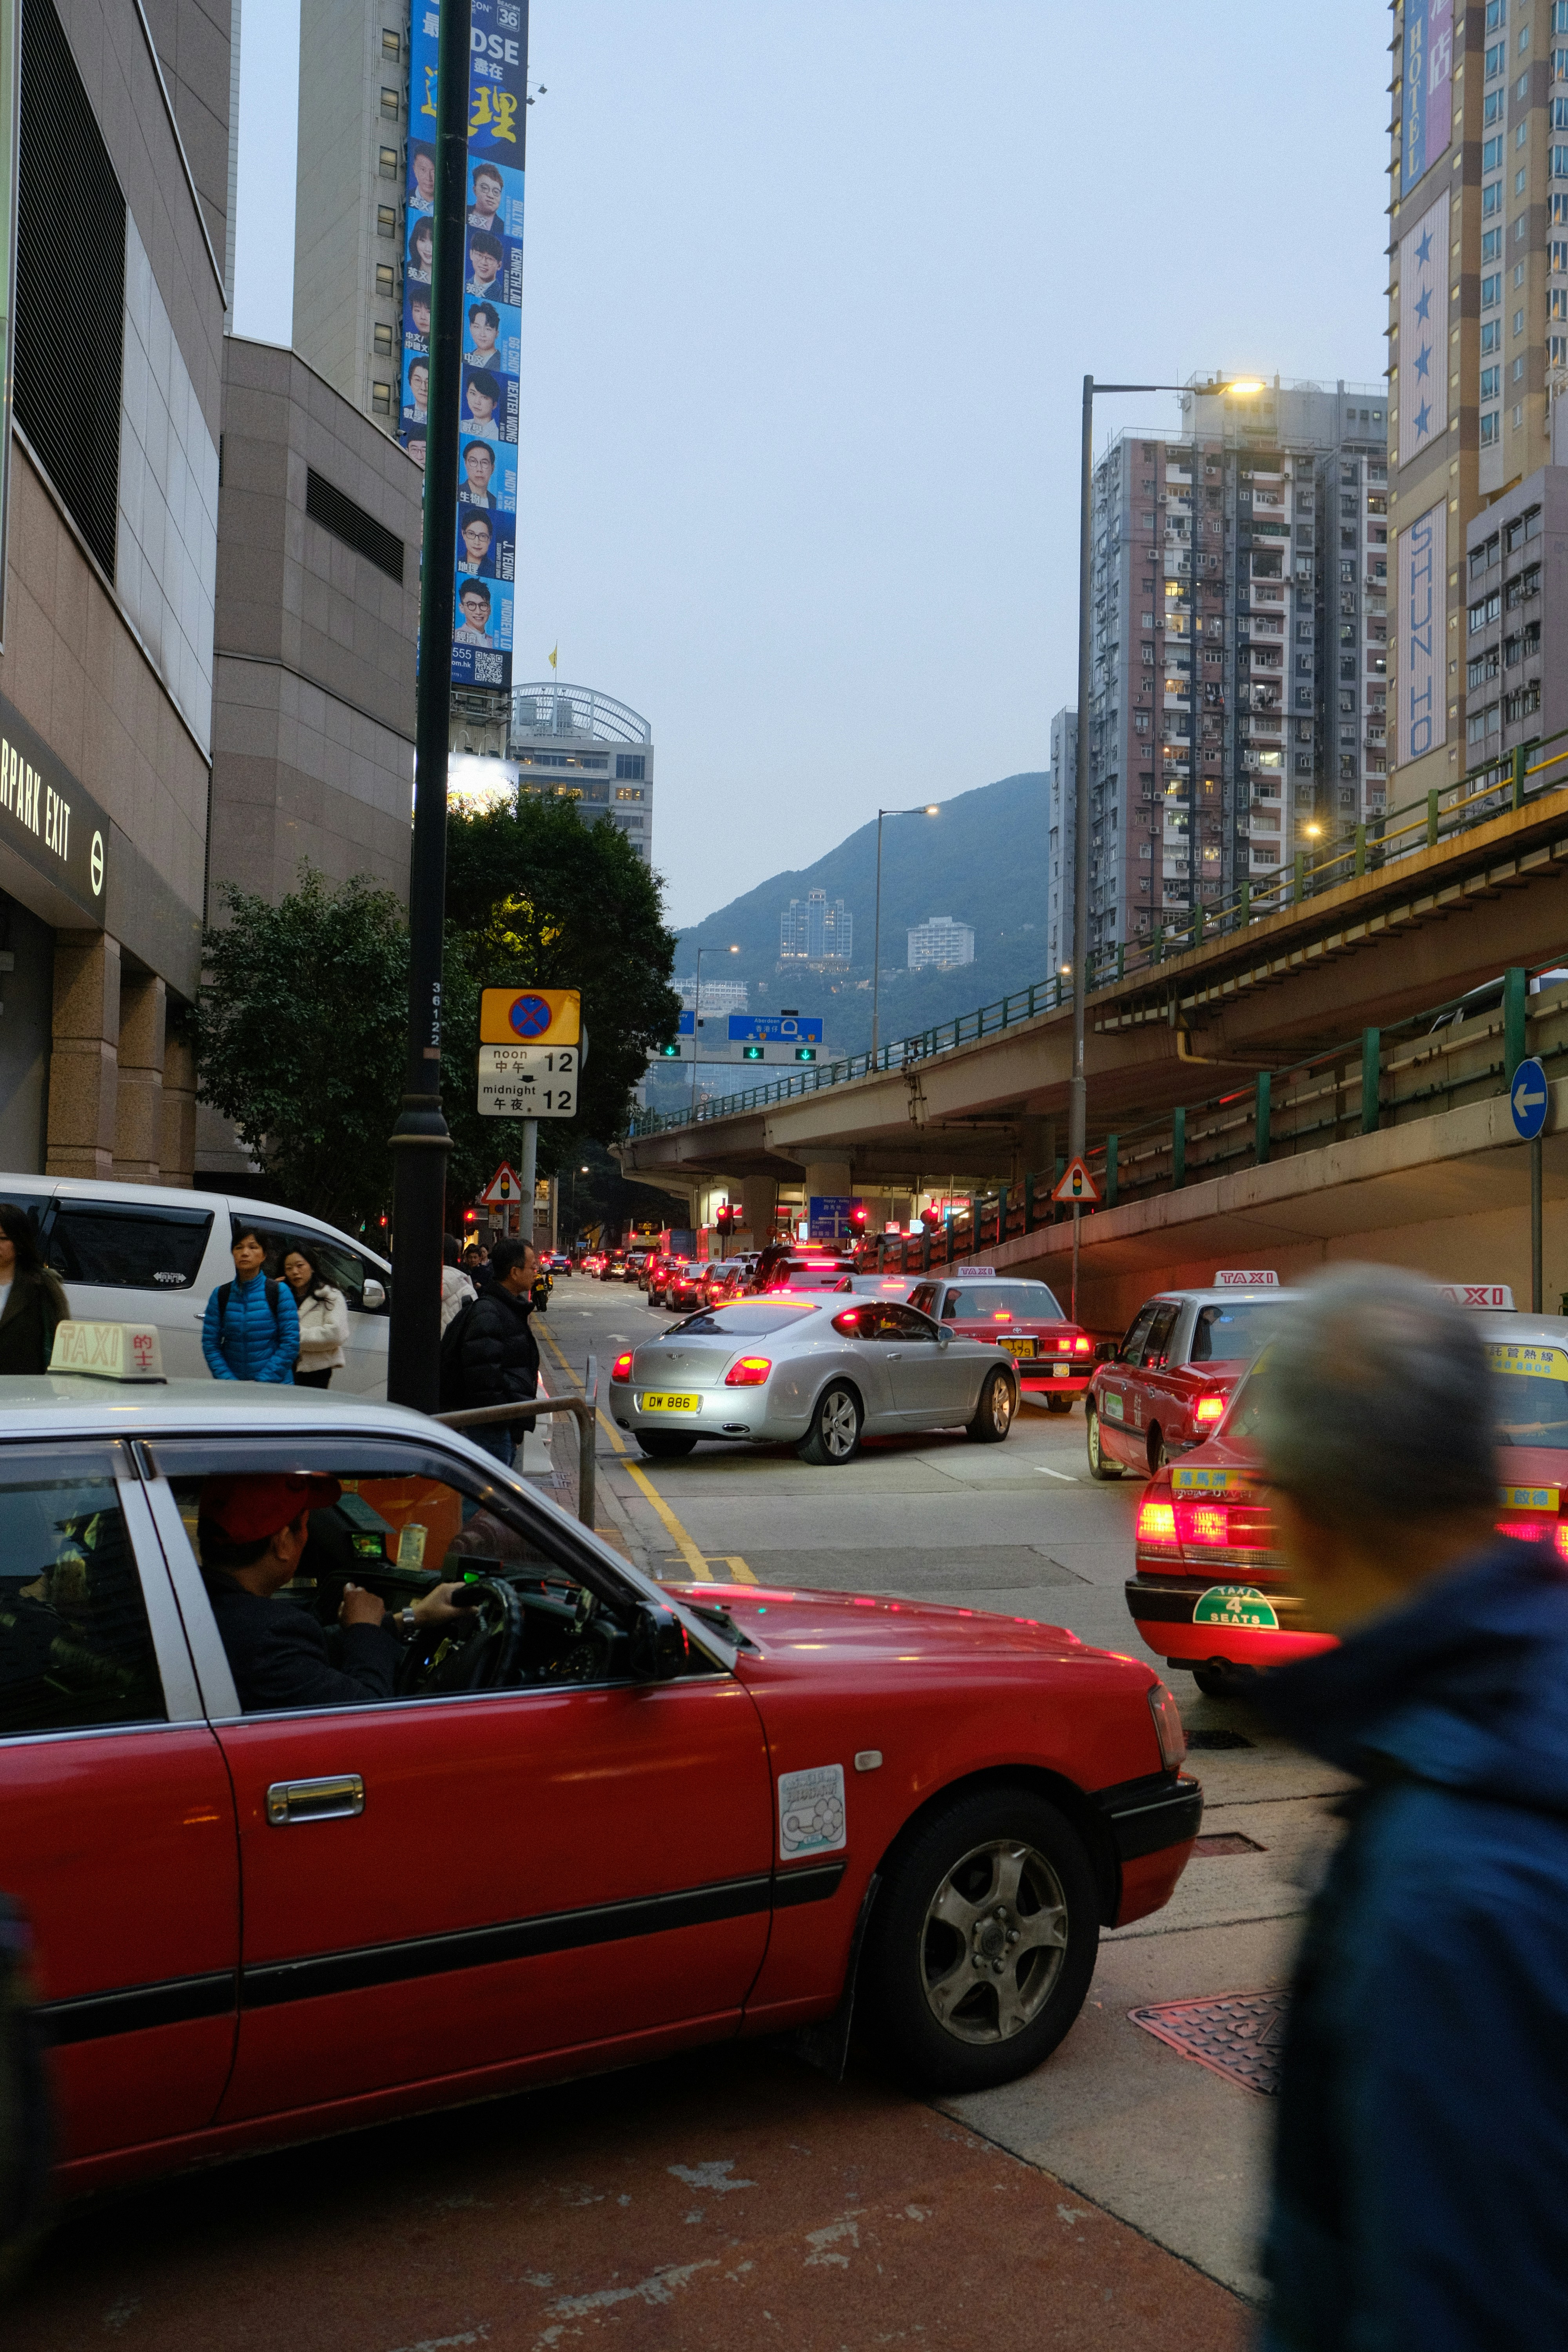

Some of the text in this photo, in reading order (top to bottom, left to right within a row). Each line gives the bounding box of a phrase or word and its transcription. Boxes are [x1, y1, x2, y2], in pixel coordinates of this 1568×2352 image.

[499, 8, 517, 26] 36
[471, 26, 519, 65] DSE
[474, 58, 503, 80] 盡在
[1408, 16, 1422, 179] HOTEL
[410, 196, 430, 211] 英文
[468, 213, 487, 227] 英文
[513, 200, 523, 224] BILLY
[408, 267, 428, 281] 英文
[510, 247, 522, 306] KENNETH LAU
[466, 283, 485, 297] 英文
[405, 341, 429, 353] 中國文
[465, 353, 483, 365] 中文
[506, 380, 518, 443] DEXTER WONG
[460, 491, 481, 505] 生物
[504, 469, 516, 512] ANDY TSE
[458, 561, 478, 575] 地理
[502, 553, 514, 580] YEUNG
[501, 599, 512, 649] ANDREW LO
[457, 631, 477, 644] 經濟
[452, 647, 471, 659] 555
[0, 738, 70, 861] RPARK EXIT
[431, 982, 440, 1045] 36122
[495, 1060, 524, 1073] 中午
[544, 1053, 572, 1072] 12
[483, 1085, 572, 1109] midnight 12
[494, 1098, 523, 1110] 午夜
[1221, 1273, 1273, 1283] TAXI
[60, 1325, 117, 1367] TAXI
[134, 1335, 153, 1366] 的士
[649, 1397, 690, 1408] DW 886
[1218, 1587, 1252, 1597] TAXI
[1226, 1597, 1242, 1613] 4
[1210, 1612, 1260, 1624] SEATS
